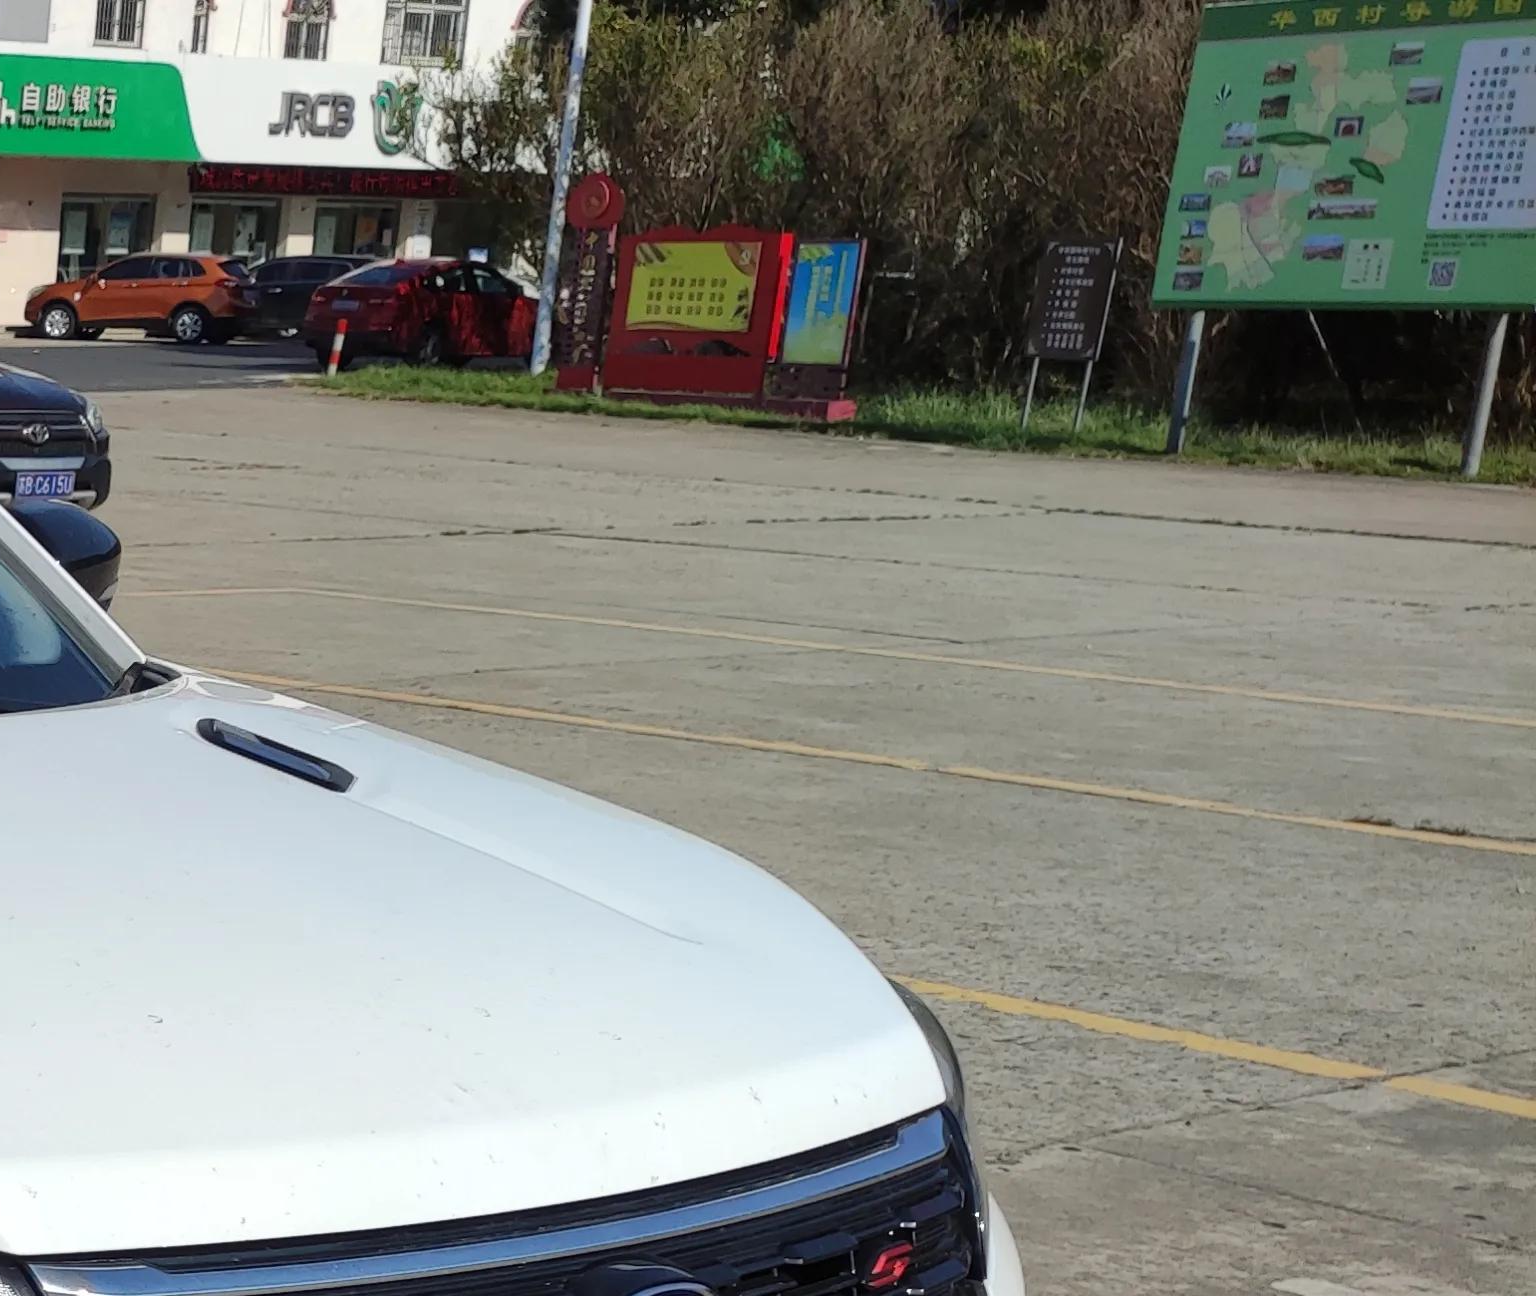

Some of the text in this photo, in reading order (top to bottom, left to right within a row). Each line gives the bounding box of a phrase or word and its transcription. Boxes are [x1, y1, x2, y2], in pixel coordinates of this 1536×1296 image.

[21, 83, 117, 115] 自助银行
[268, 91, 356, 139] JRCB
